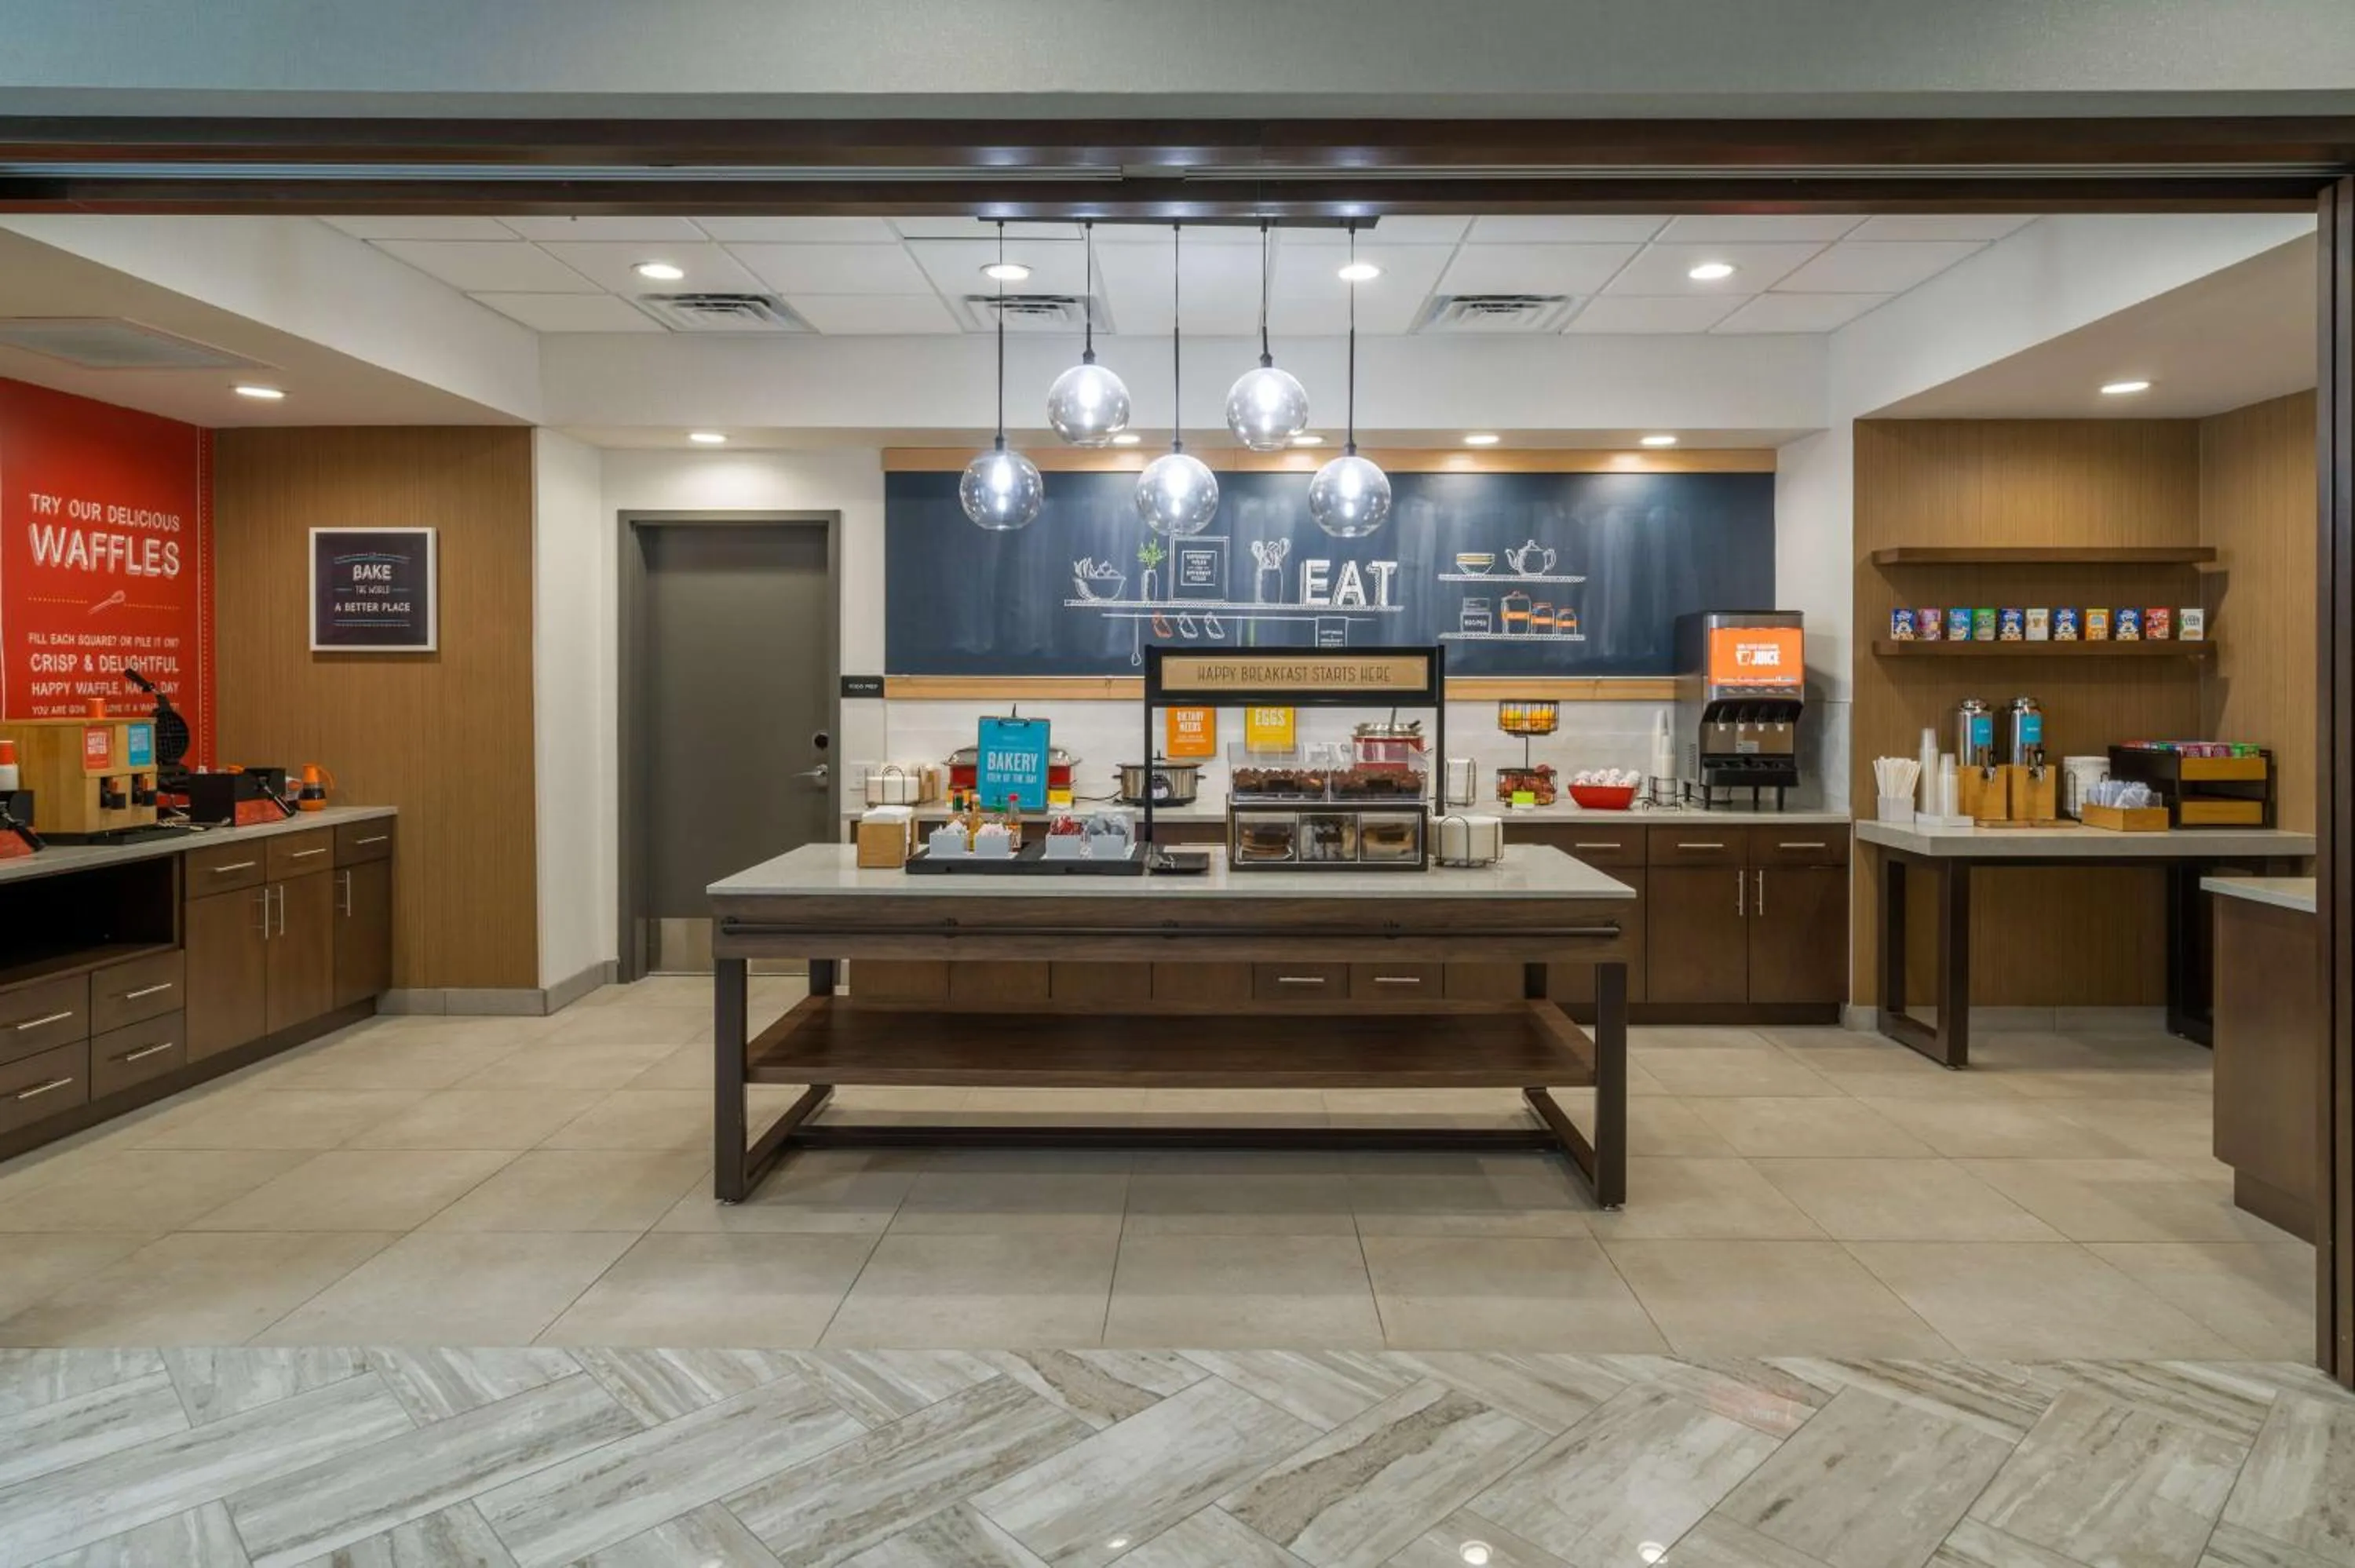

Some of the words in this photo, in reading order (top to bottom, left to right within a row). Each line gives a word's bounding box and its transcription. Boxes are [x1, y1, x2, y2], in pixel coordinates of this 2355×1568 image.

[29, 493, 62, 516] TRY
[68, 498, 102, 522] OUR
[107, 505, 181, 533] DELICIOUS
[28, 522, 181, 579] WAFFLES
[352, 563, 392, 582] BAKE
[1300, 560, 1398, 607] EAT
[334, 602, 342, 612] A
[345, 602, 379, 612] BETTER
[382, 602, 411, 612] PLACE
[49, 633, 75, 645] EACH
[30, 653, 78, 673] CRISP
[84, 654, 94, 673] &
[99, 655, 181, 673] DELIGHTFUL
[1198, 665, 1237, 683] HAPPY
[1240, 665, 1308, 683] BREAKFAST
[1312, 665, 1356, 683] STARTS
[1360, 665, 1393, 683] HERE
[31, 682, 70, 695] HAPPY
[75, 681, 122, 697] WAFFLE,
[159, 681, 180, 694] DAY
[1255, 707, 1286, 726] EGGS
[988, 751, 1039, 772] BAKERY
